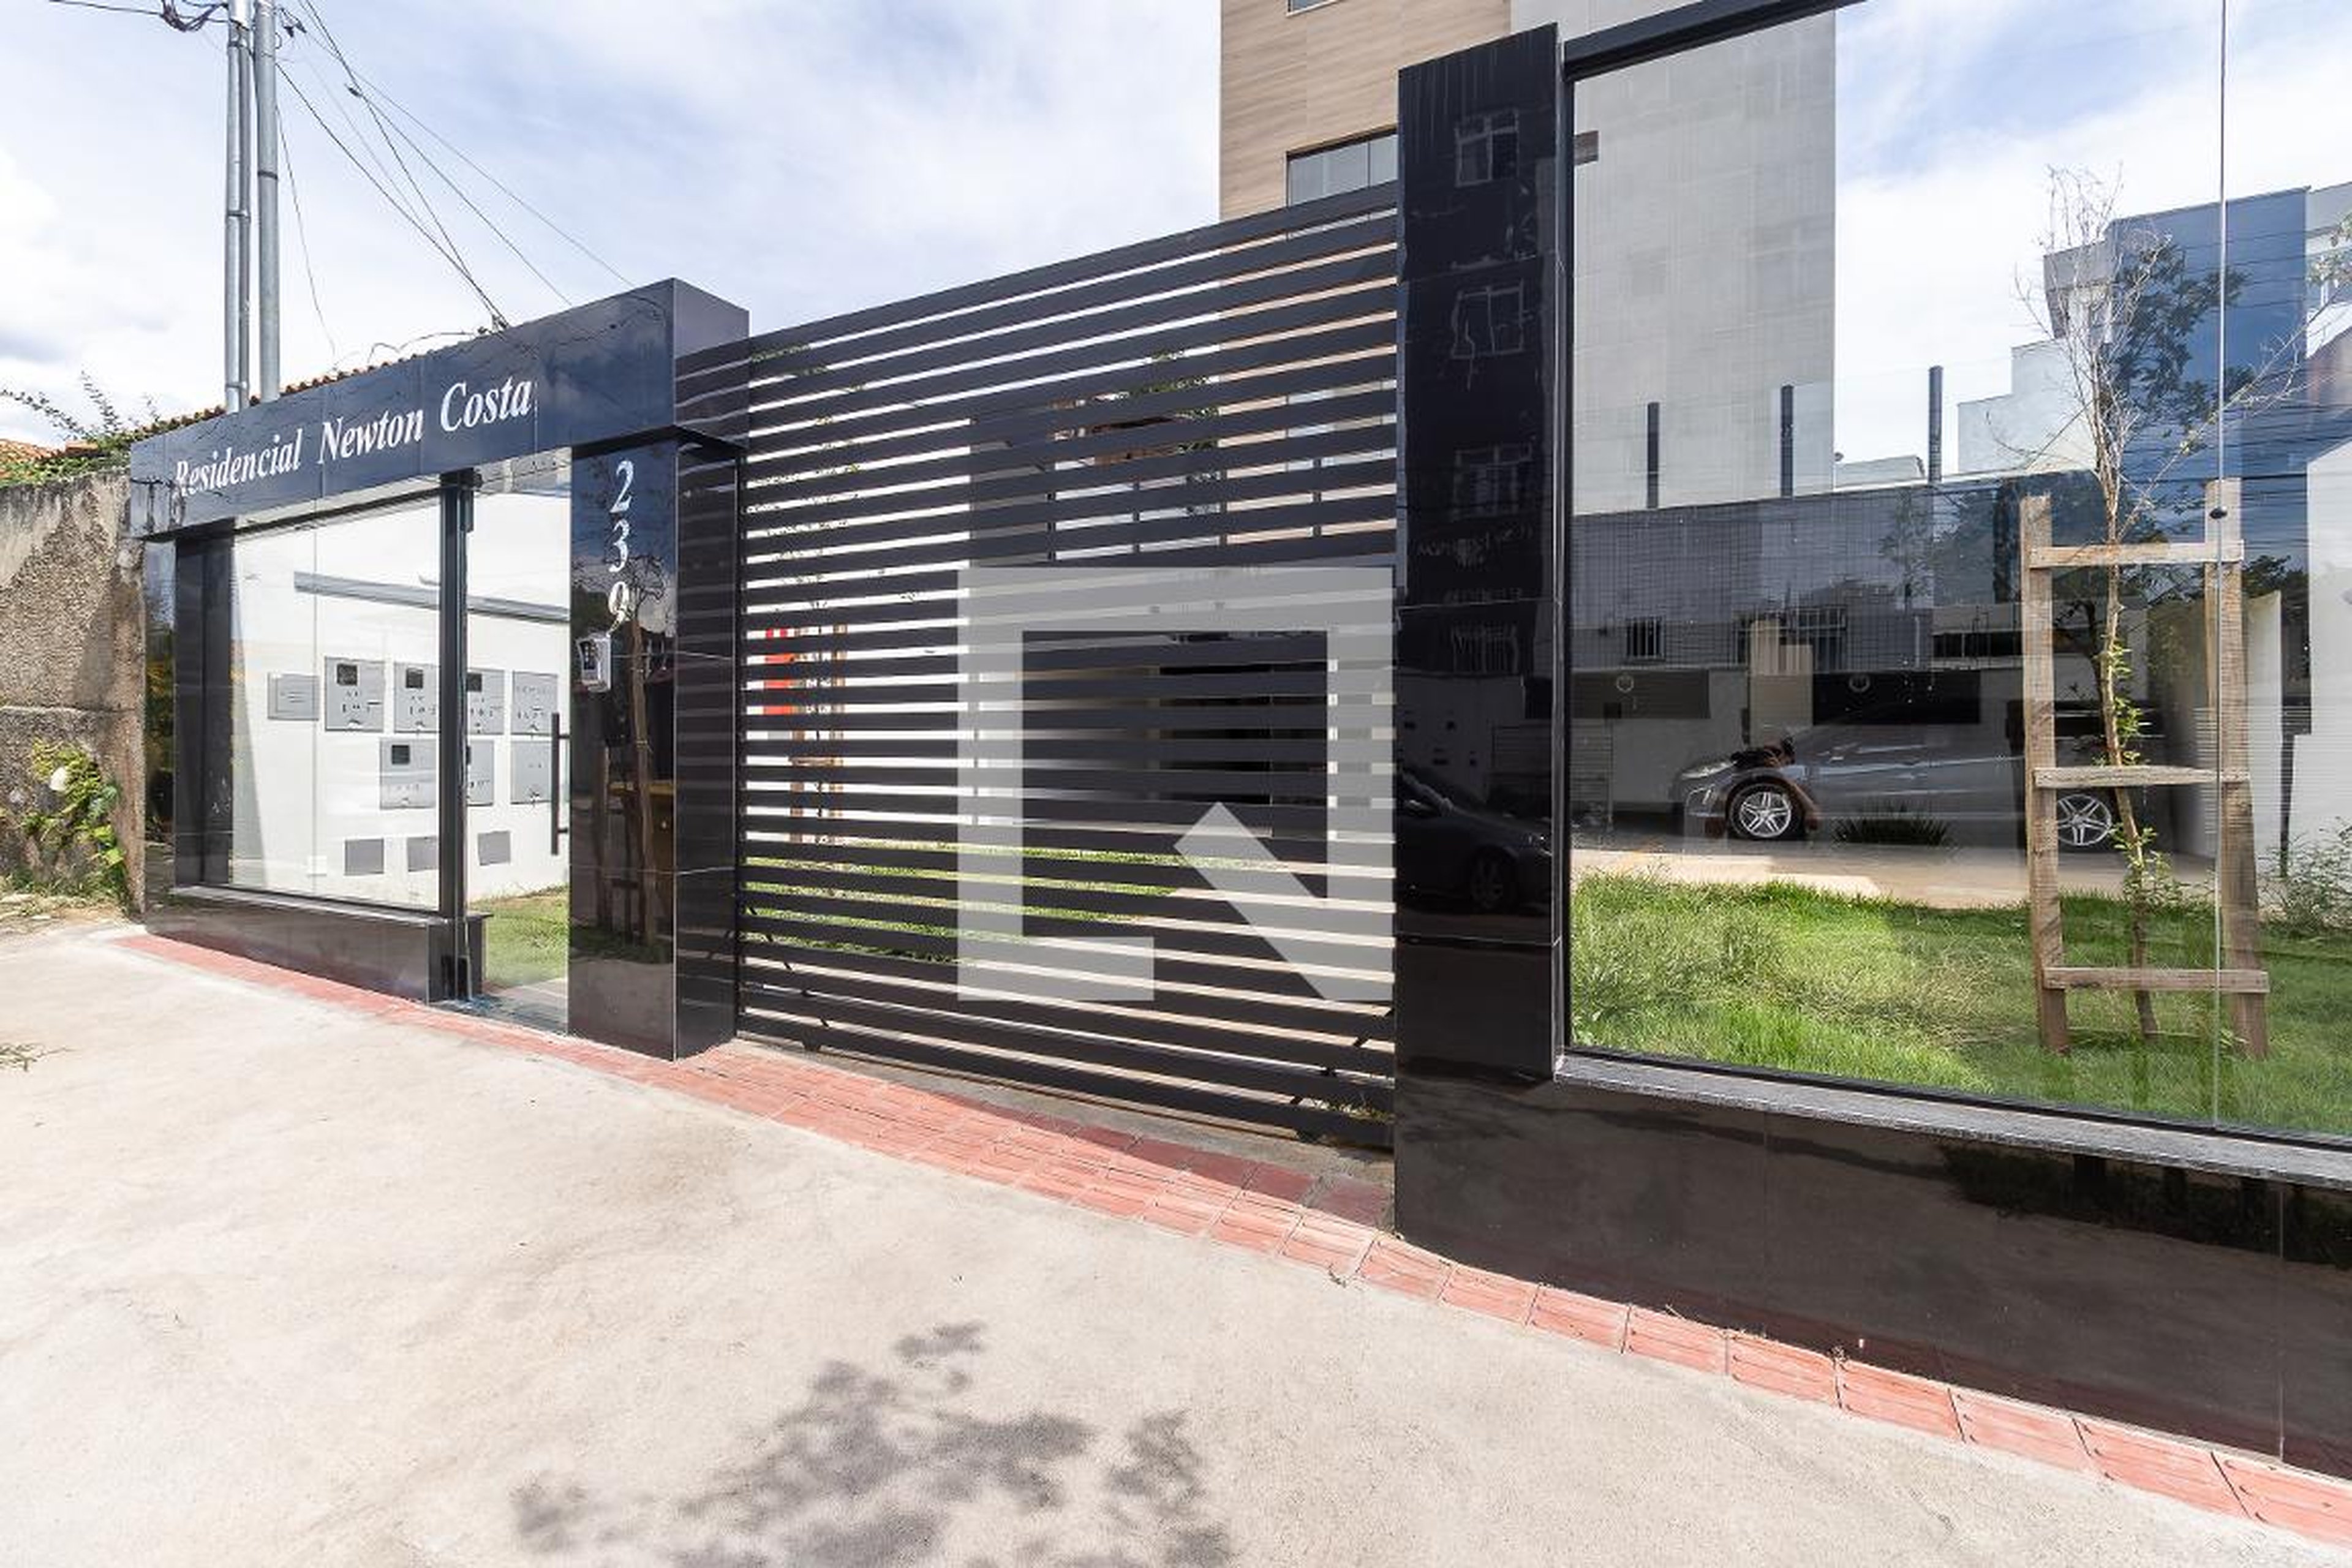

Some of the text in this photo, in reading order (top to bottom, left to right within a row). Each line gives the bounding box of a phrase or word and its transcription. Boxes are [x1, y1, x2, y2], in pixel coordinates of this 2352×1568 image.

[173, 376, 532, 497] Residencial Newton Costa
[605, 459, 635, 638] 239
